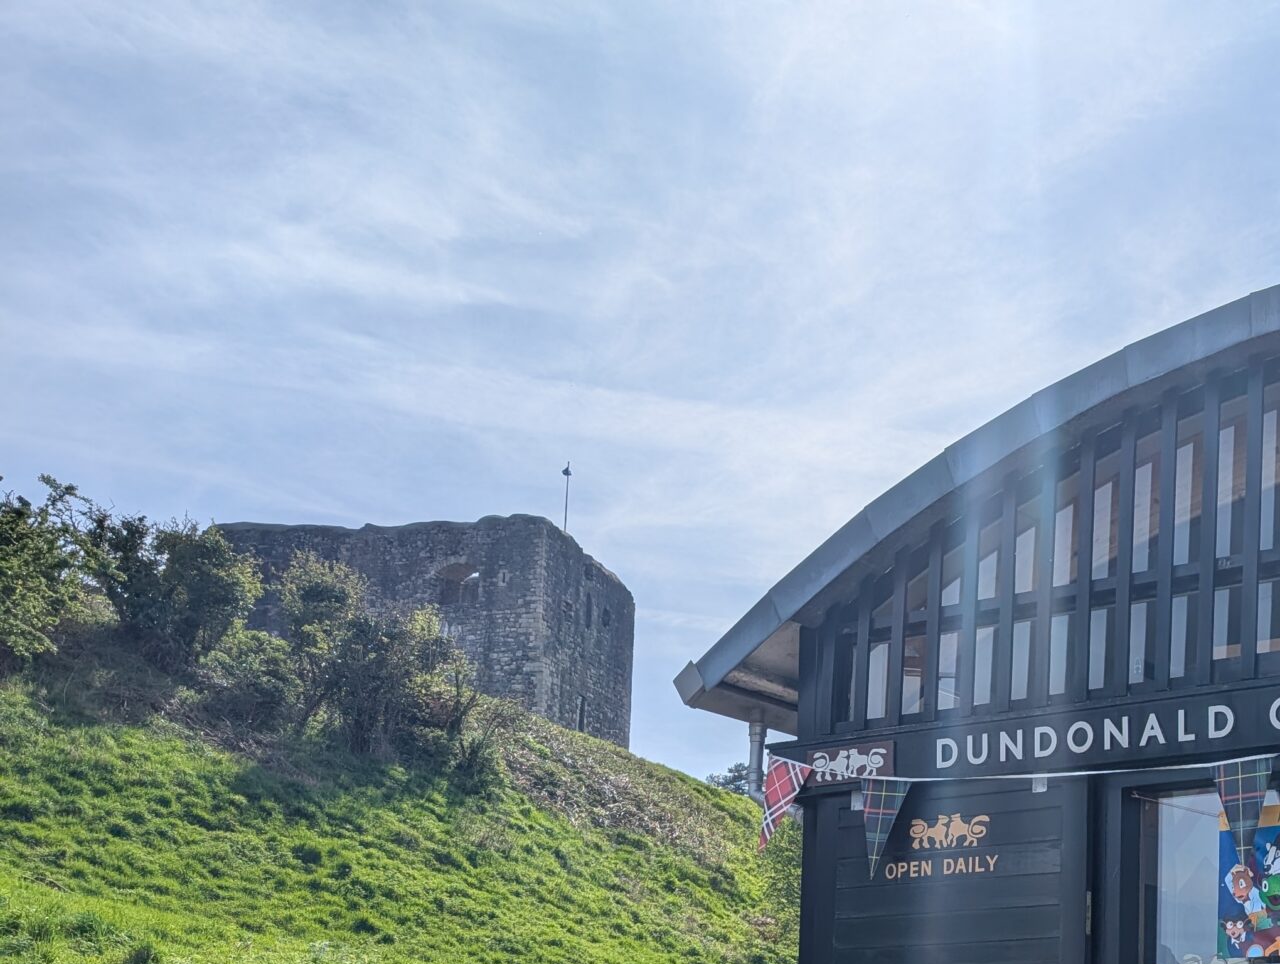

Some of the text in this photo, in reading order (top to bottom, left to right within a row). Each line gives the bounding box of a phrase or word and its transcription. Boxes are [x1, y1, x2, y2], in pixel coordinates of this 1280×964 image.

[936, 704, 1234, 769] DUNDONALD
[885, 854, 999, 880] OPEN DAILY
